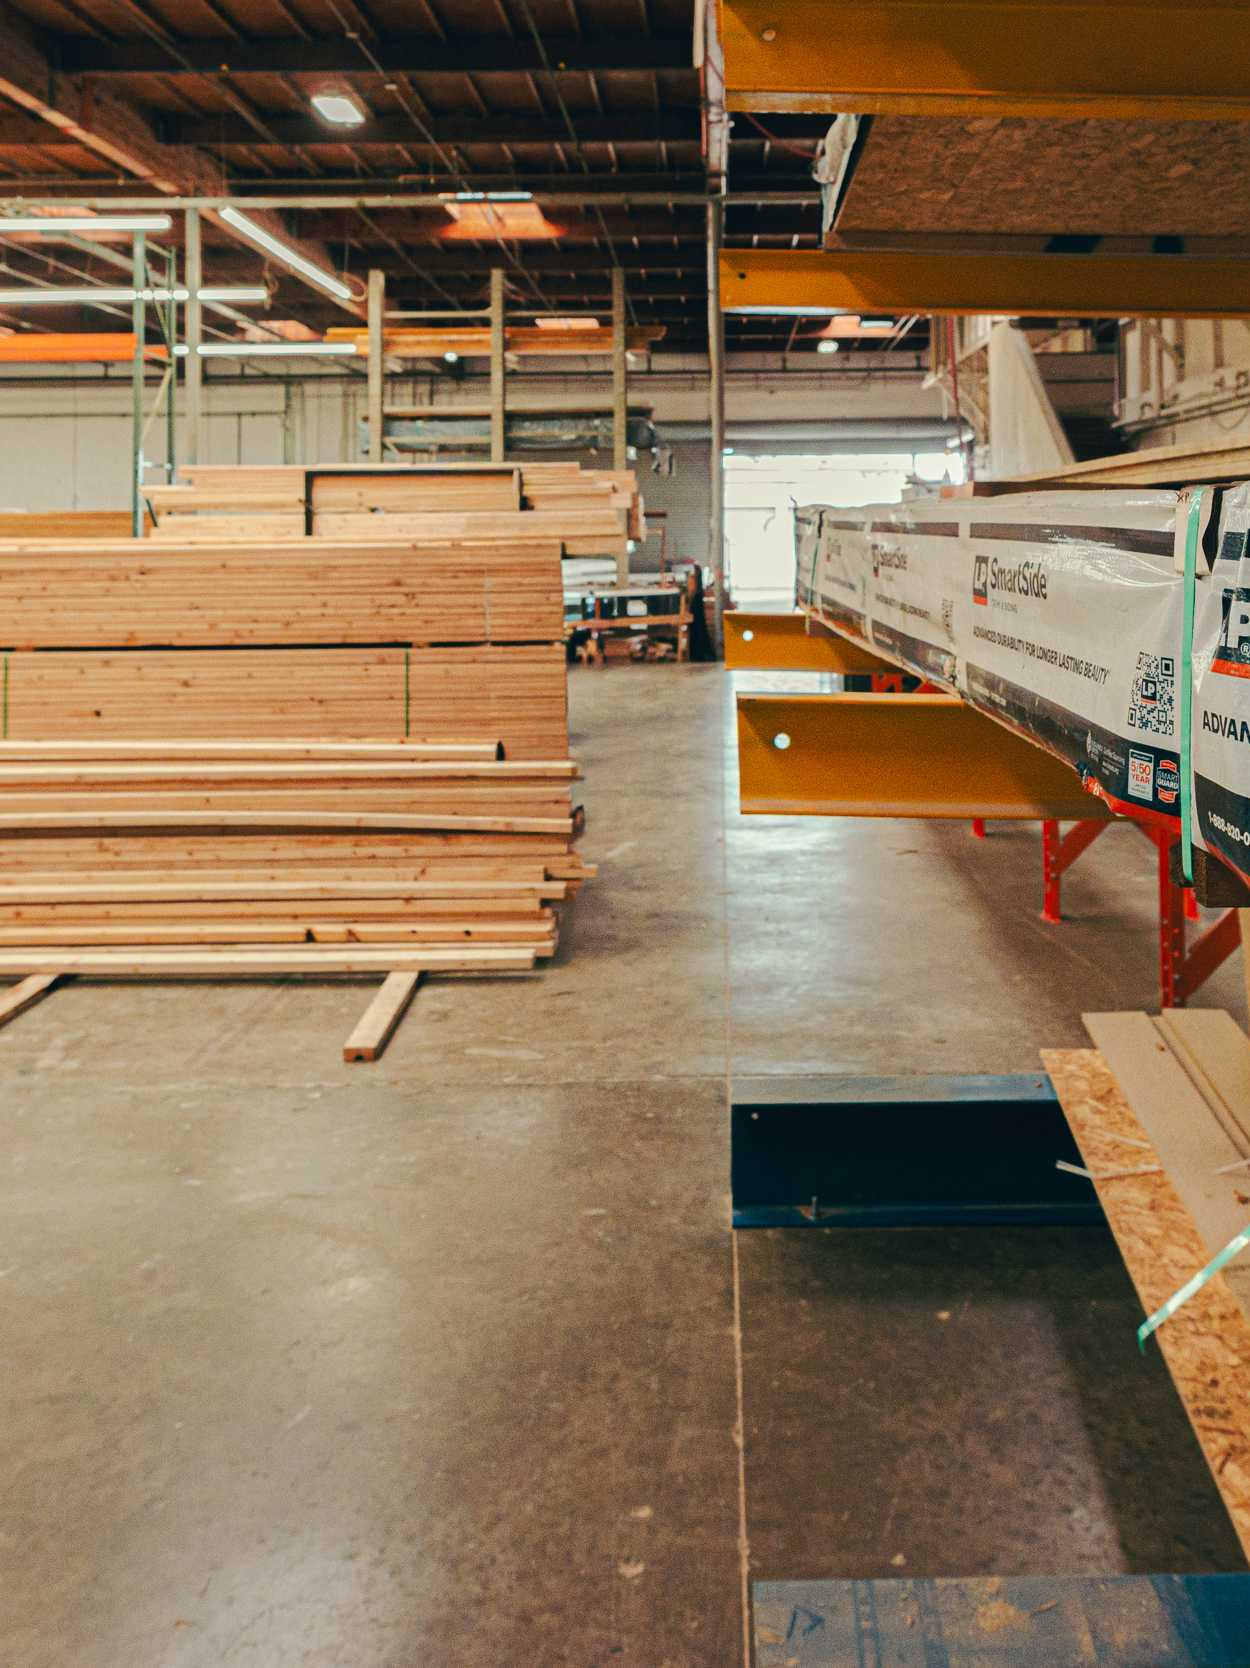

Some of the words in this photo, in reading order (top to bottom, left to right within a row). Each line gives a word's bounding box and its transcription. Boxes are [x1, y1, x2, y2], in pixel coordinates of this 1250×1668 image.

[991, 557, 1047, 600] SmartSide
[1025, 641, 1036, 658] FOR
[1036, 645, 1058, 666] LONGER
[1058, 652, 1084, 675] LASTING
[1083, 662, 1108, 685] BEAUTY
[1132, 773, 1151, 784] YEAR
[1157, 777, 1179, 789] GUARD
